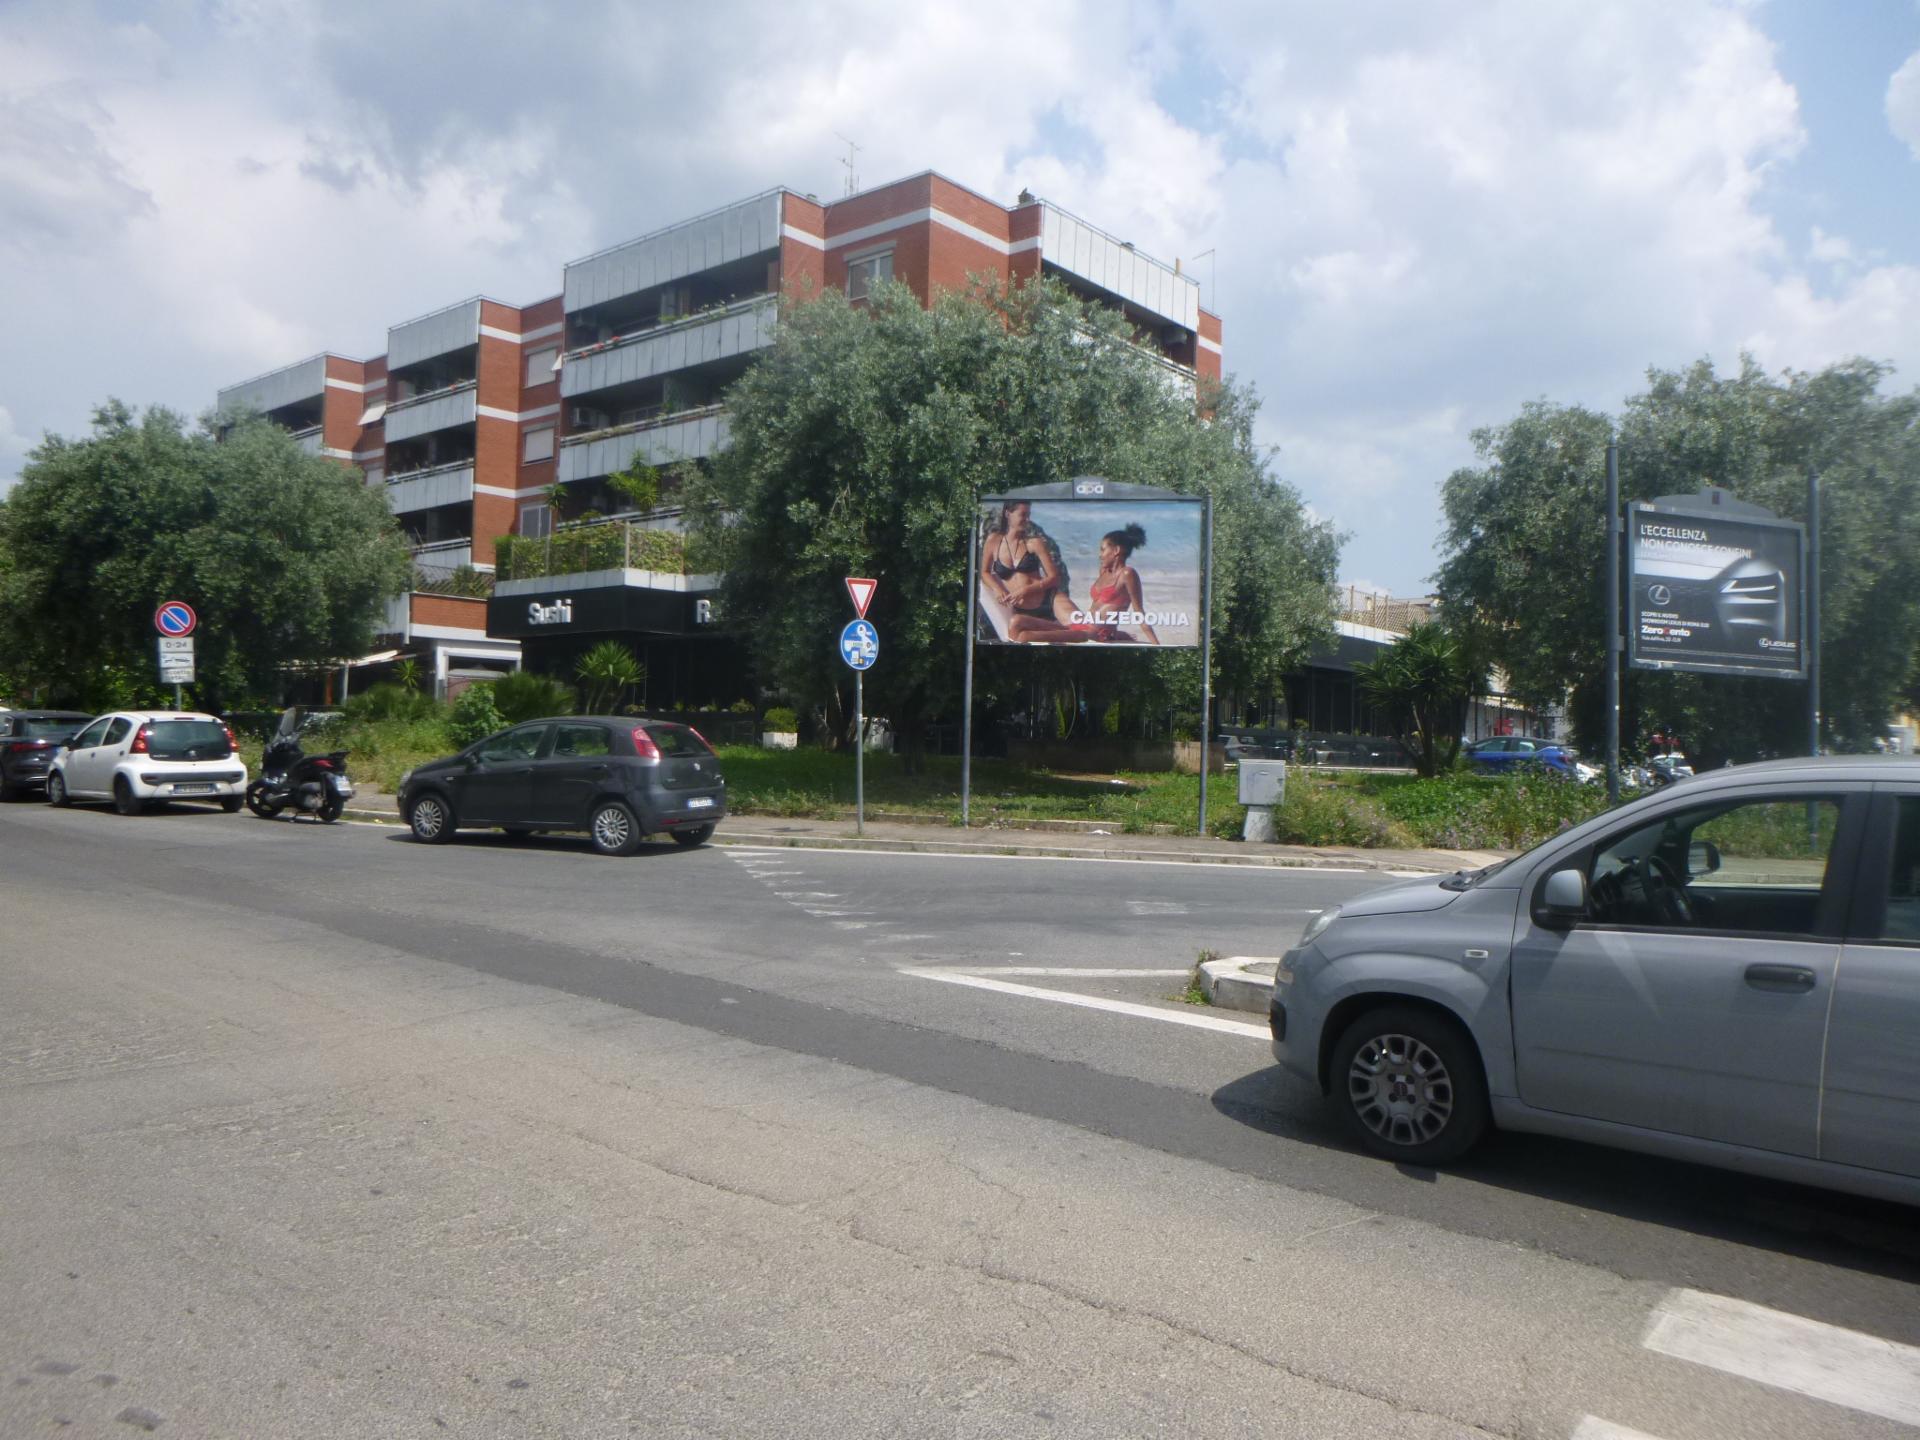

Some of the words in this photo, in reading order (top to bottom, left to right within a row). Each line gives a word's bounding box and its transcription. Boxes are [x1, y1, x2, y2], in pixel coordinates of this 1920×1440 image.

[1640, 524, 1707, 541] L'ECCELLENZA
[1640, 538, 1664, 550] NON
[528, 598, 572, 625] Sushi
[1070, 611, 1189, 626] CALZEDONIA
